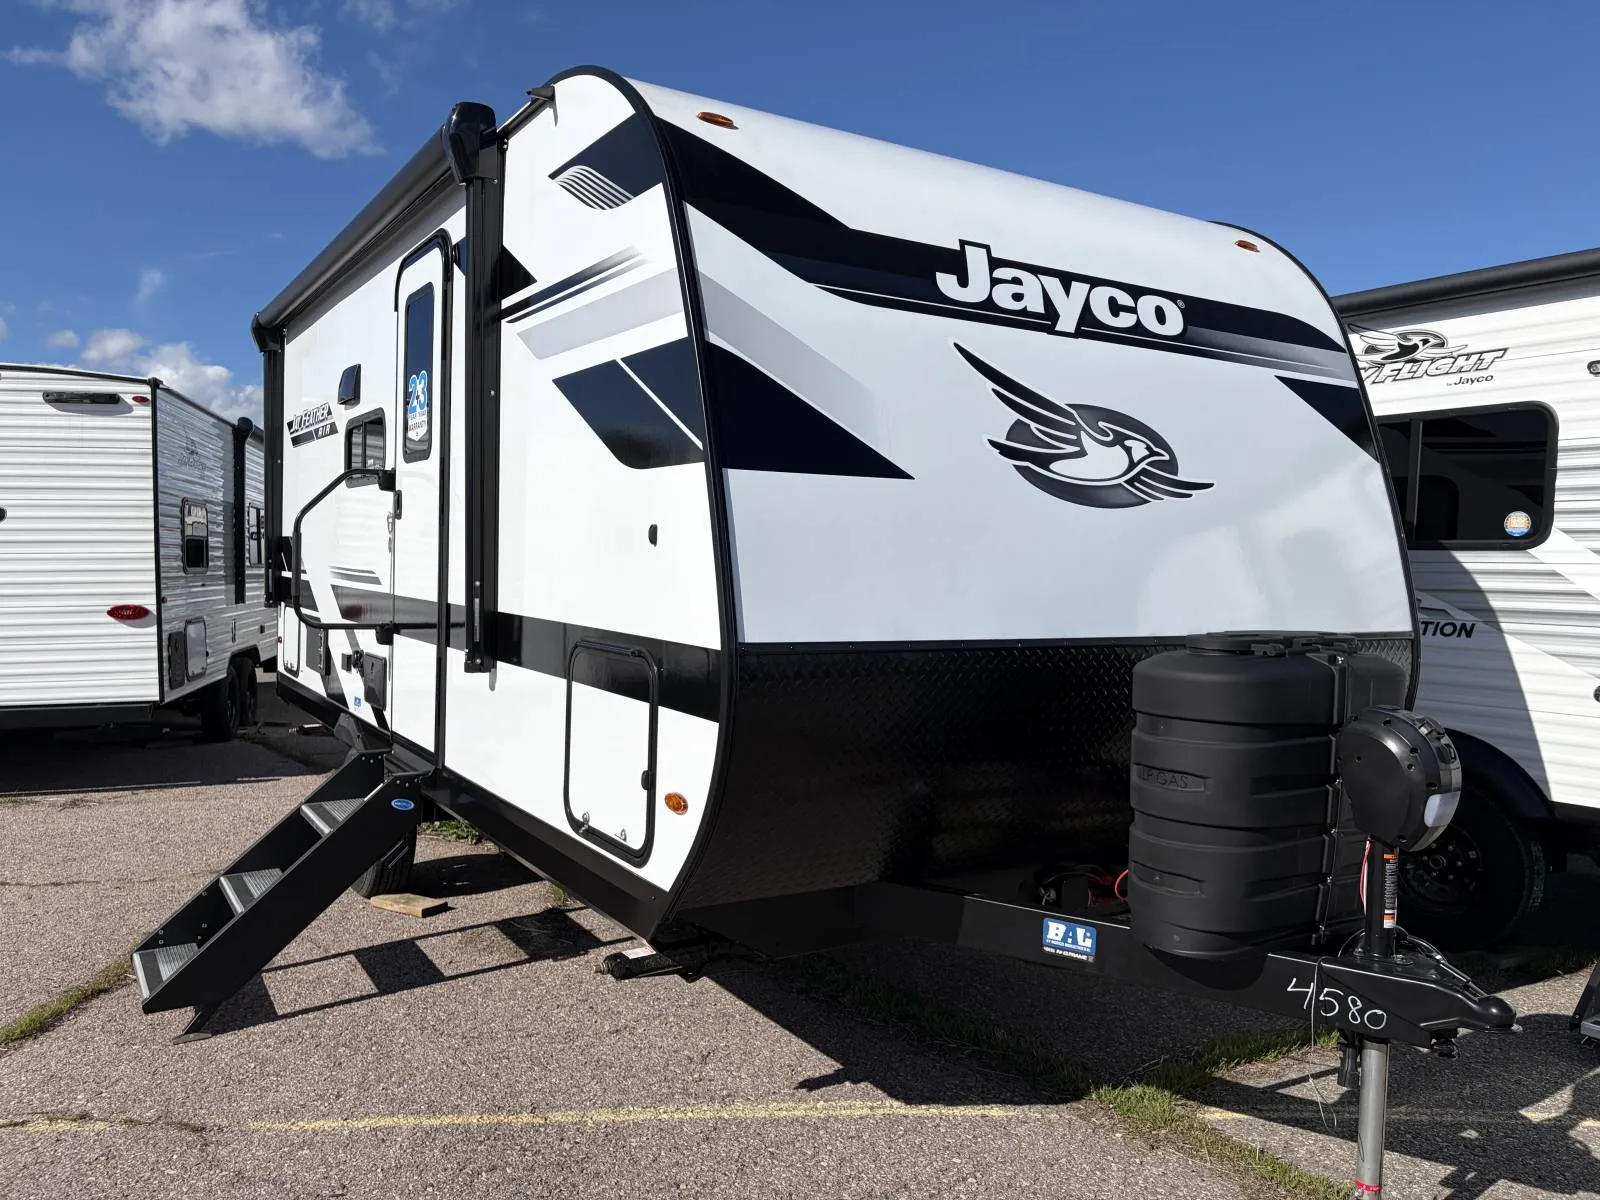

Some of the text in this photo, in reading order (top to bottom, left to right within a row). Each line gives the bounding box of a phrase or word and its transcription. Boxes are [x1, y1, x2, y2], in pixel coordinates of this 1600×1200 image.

[935, 243, 1184, 336] Jayco
[1371, 347, 1510, 385] FLIGHT
[1454, 374, 1494, 386] Jayco
[317, 424, 331, 438] AIR
[1156, 771, 1188, 788] GAS
[1287, 978, 1387, 1030] 4580
